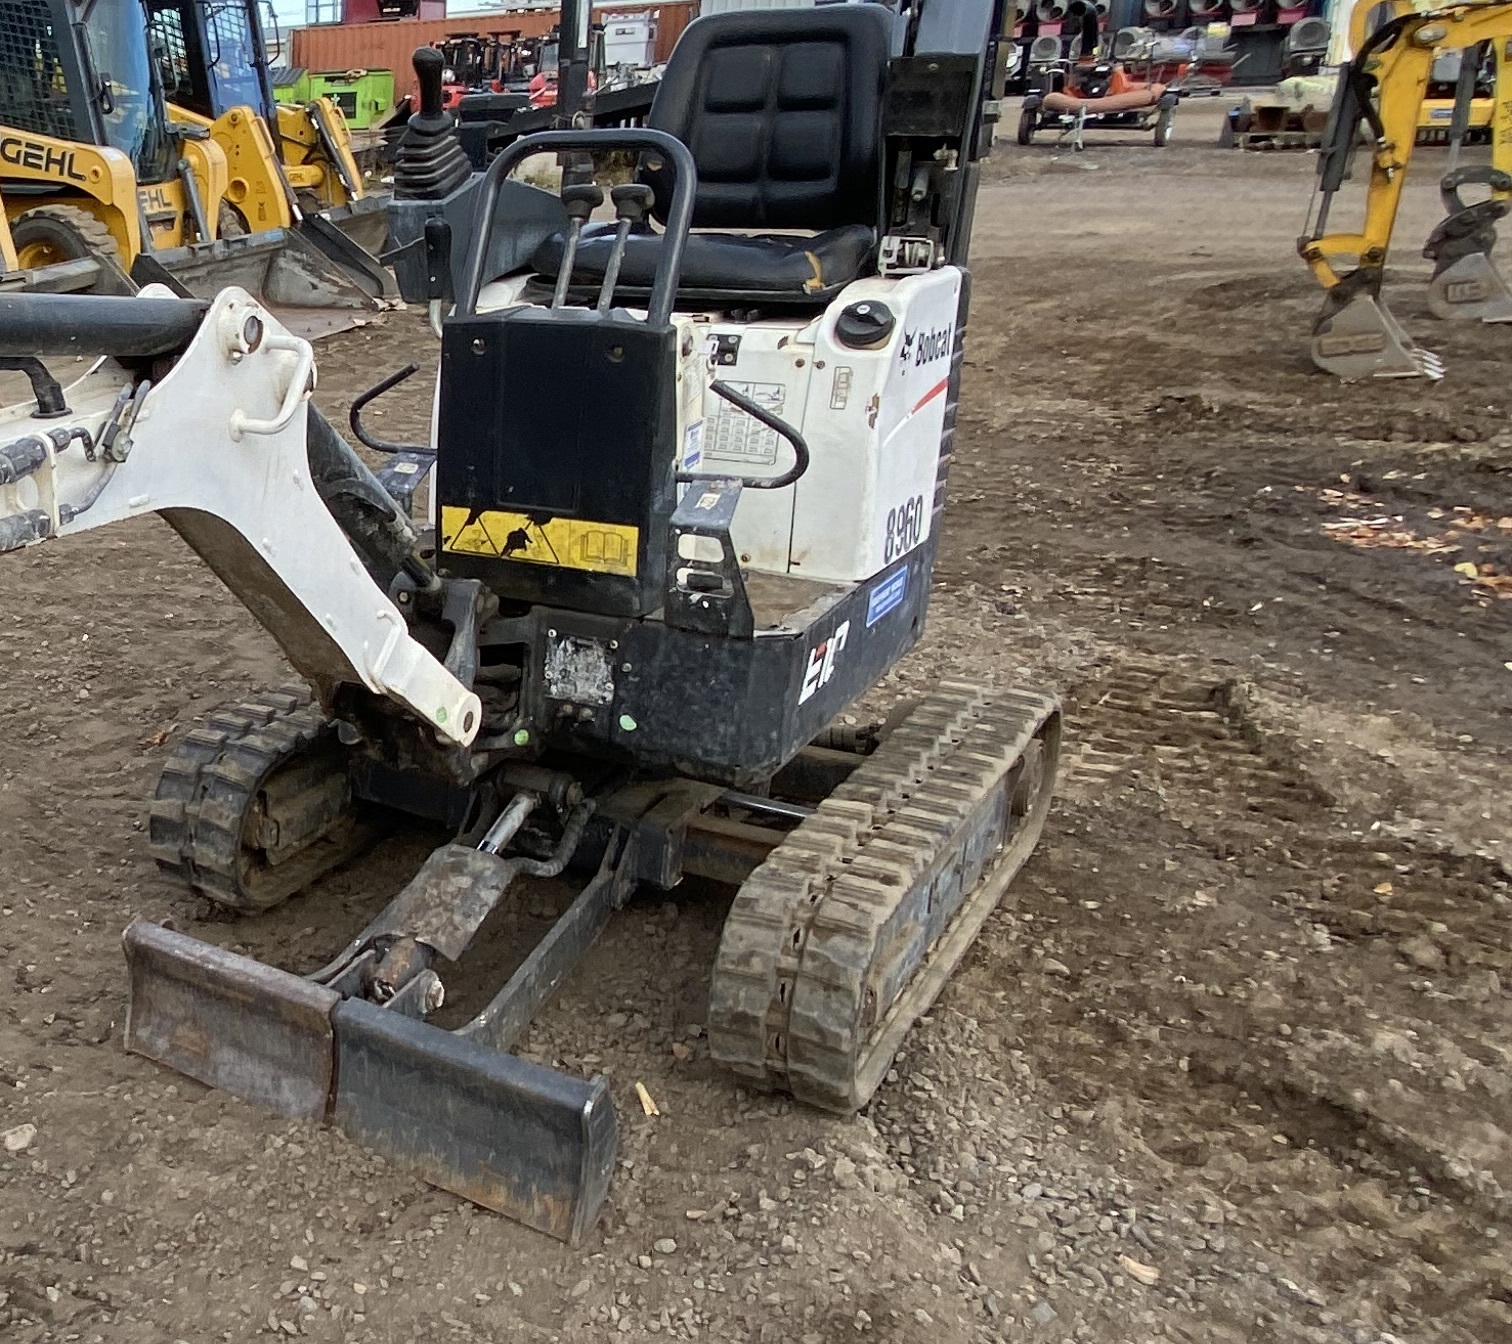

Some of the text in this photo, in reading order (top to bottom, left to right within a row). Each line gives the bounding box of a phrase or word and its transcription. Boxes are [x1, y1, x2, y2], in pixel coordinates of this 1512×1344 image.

[0, 137, 87, 182] GEHL
[138, 188, 173, 208] EHL
[915, 323, 952, 367] Bobcat
[884, 494, 924, 564] 8960
